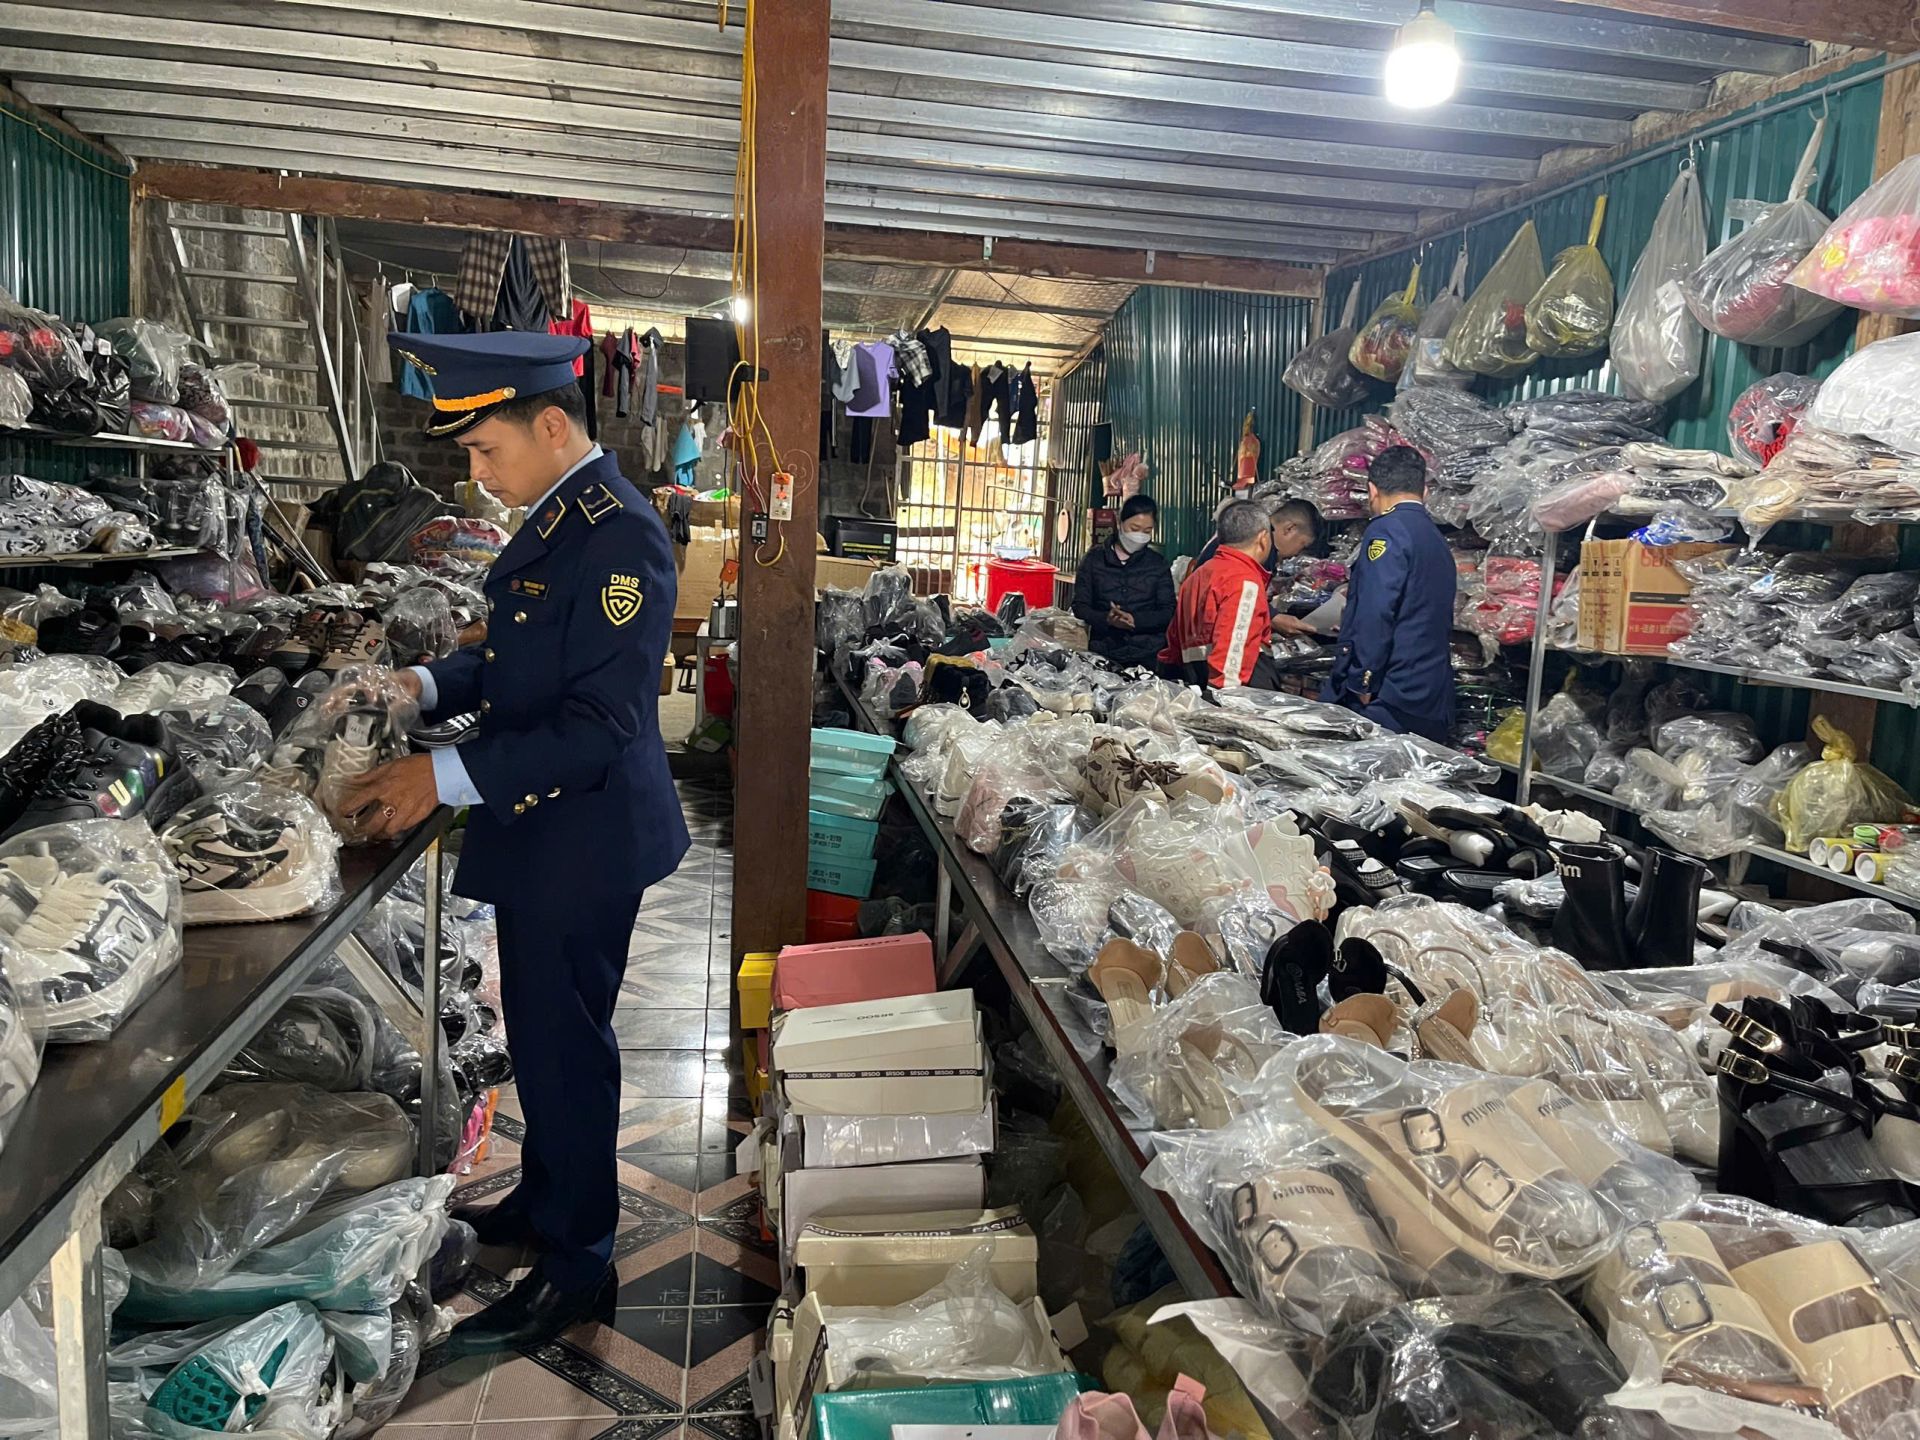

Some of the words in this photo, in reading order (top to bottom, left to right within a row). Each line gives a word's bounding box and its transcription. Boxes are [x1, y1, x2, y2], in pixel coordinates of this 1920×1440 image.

[610, 573, 640, 588] DMS
[805, 1224, 863, 1237] ASHION
[972, 1215, 1025, 1234] FASHIO
